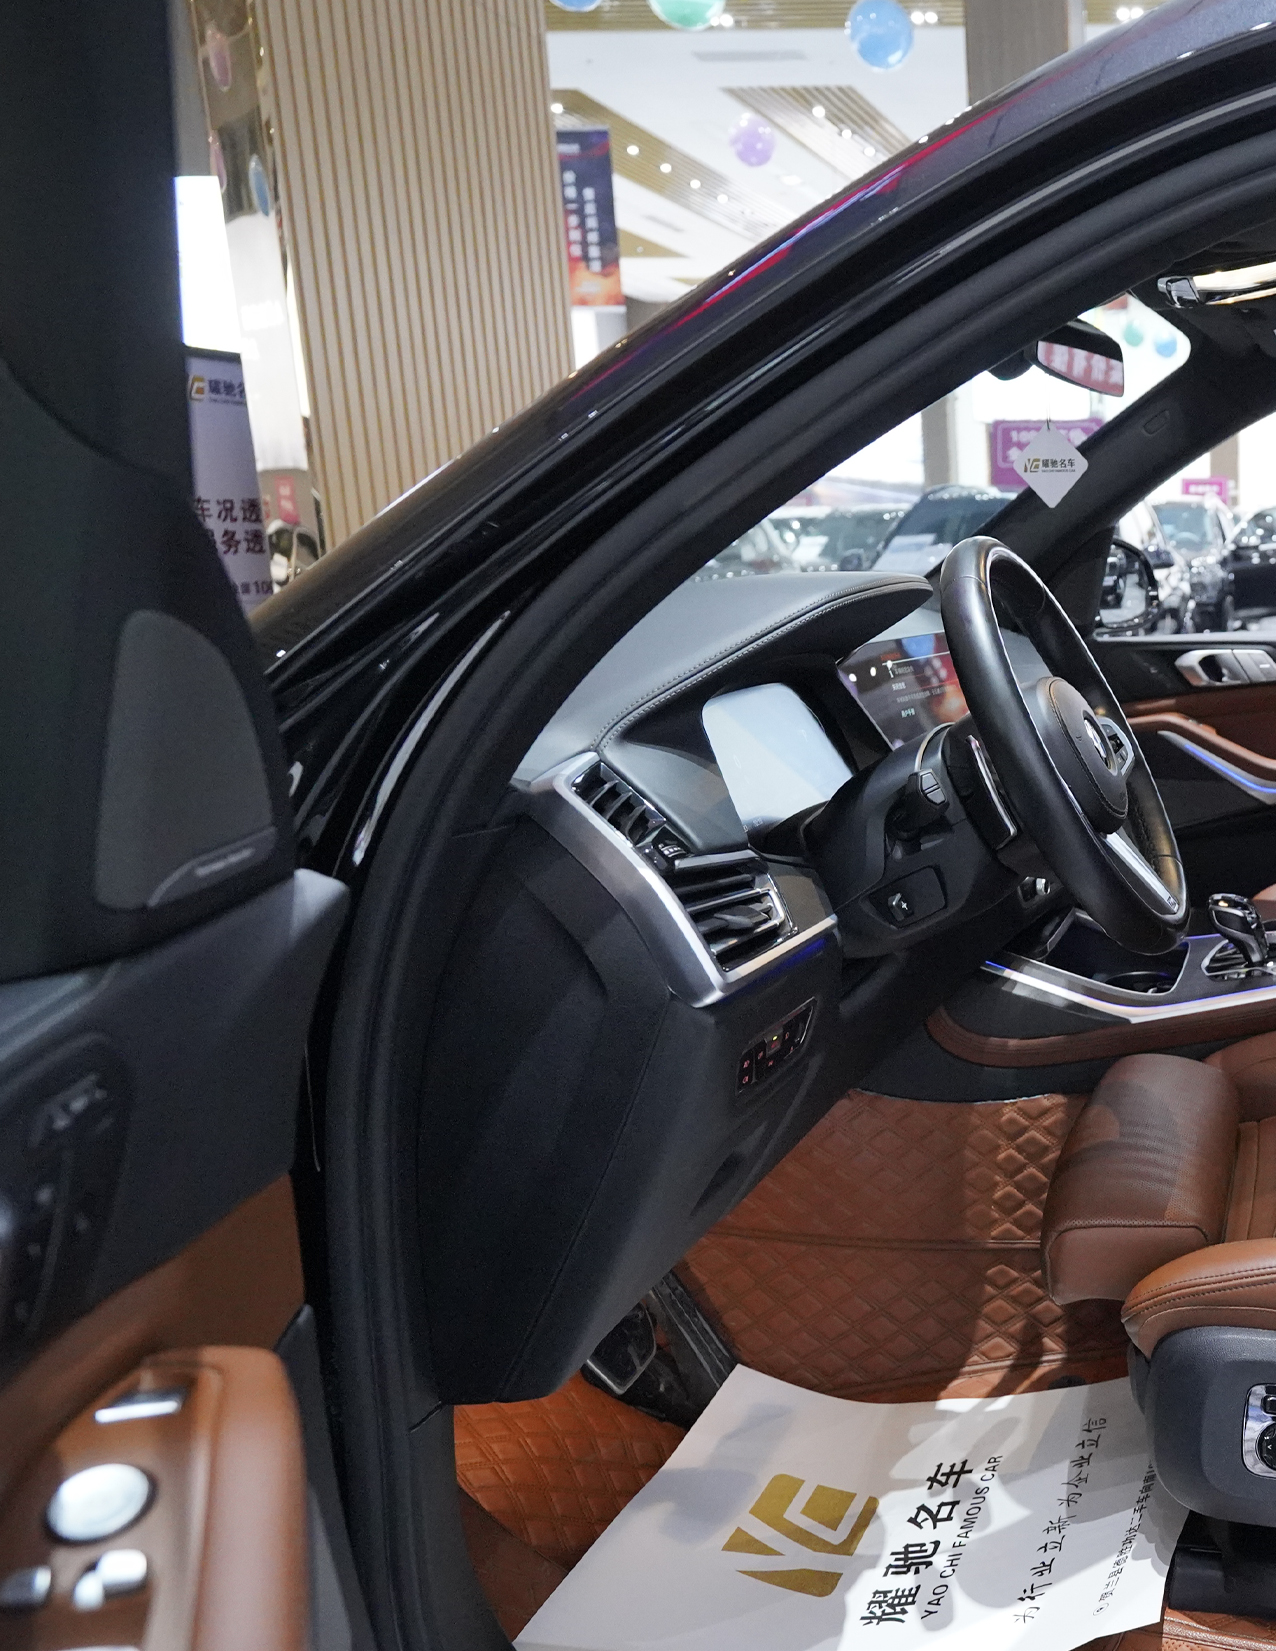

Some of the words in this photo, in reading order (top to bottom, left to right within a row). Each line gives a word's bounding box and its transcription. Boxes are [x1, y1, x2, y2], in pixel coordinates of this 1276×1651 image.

[212, 529, 266, 555] 务透
[859, 1459, 974, 1627] 耀驰名车
[920, 1584, 949, 1620] YAO
[939, 1552, 963, 1579] CHI
[952, 1486, 990, 1549] FAMOUS
[980, 1455, 1003, 1482] CAR
